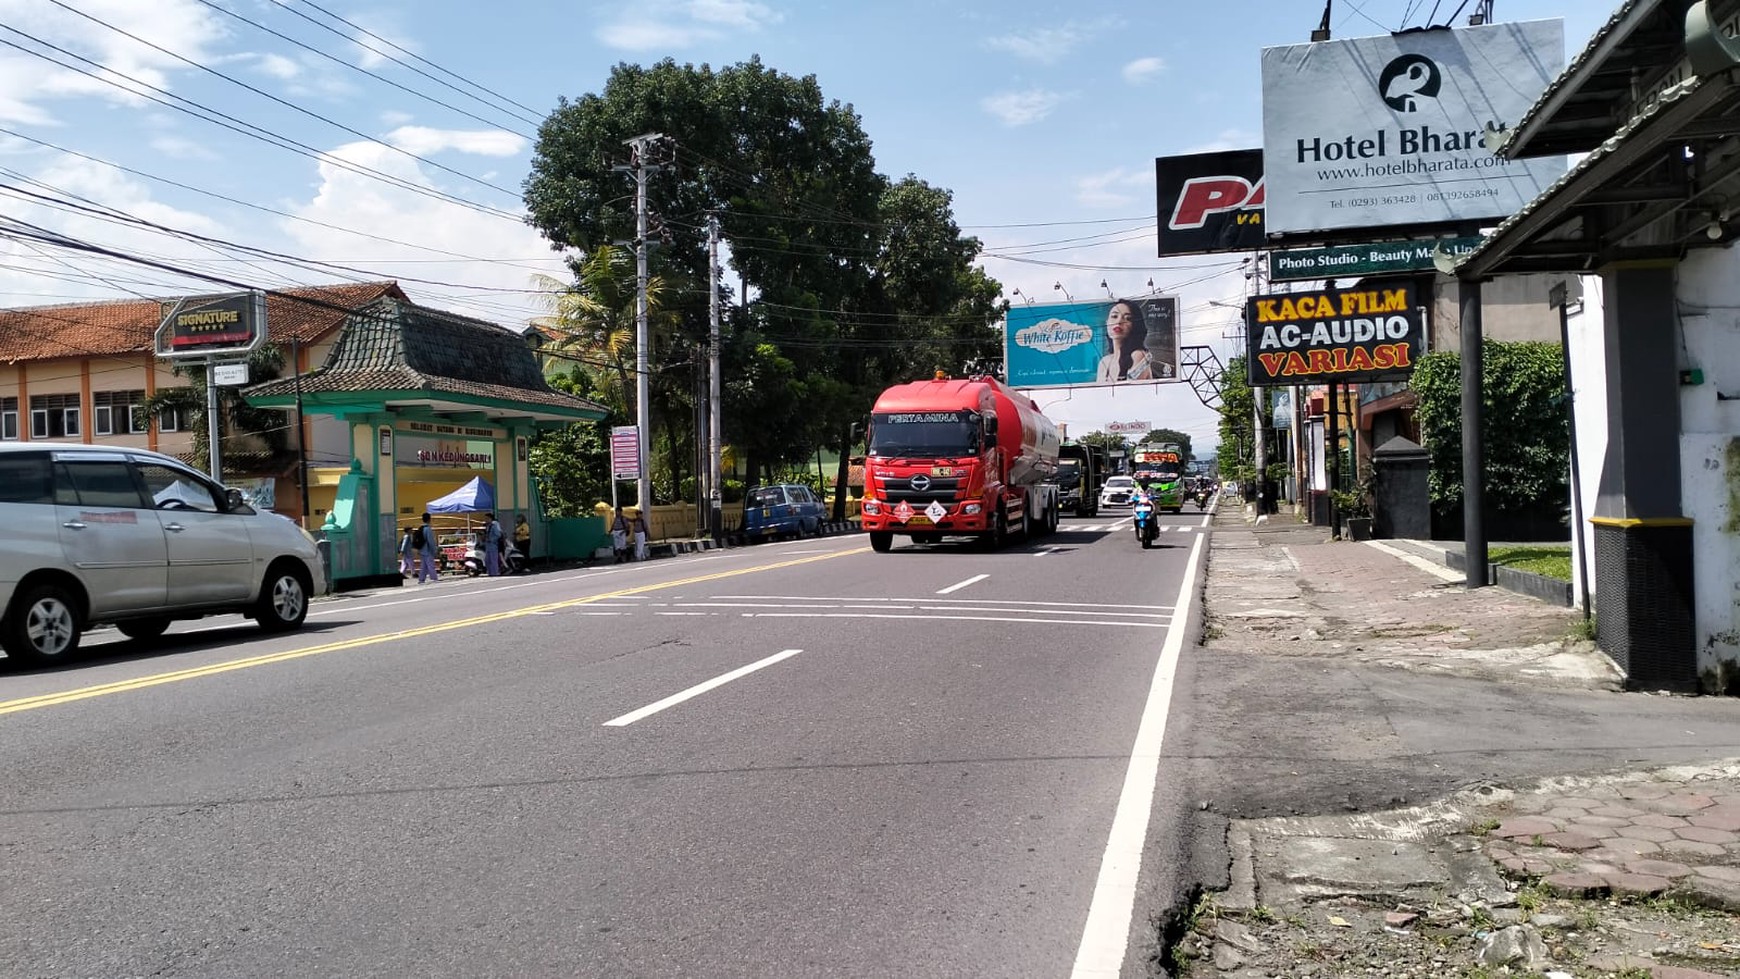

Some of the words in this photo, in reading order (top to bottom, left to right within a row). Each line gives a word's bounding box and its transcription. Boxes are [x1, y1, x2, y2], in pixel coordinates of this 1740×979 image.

[1297, 129, 1386, 163] Hotel
[1317, 156, 1511, 181] www.hotelbharata.com
[1330, 200, 1344, 209] Tel.
[1348, 197, 1379, 209] (0293)
[1381, 194, 1417, 206] 363428
[1279, 256, 1315, 270] Photo
[1318, 253, 1359, 267] Studio
[1370, 249, 1412, 264] Beauty
[1256, 295, 1336, 323] KACA
[1340, 288, 1409, 315] FILM
[177, 310, 238, 326] SIGNATURE
[1023, 331, 1051, 345] White
[1054, 329, 1084, 344] Koffie
[1259, 315, 1410, 350] AC-AUDIO
[1258, 342, 1411, 377] VARIASI
[888, 413, 959, 424] PERTAMINA
